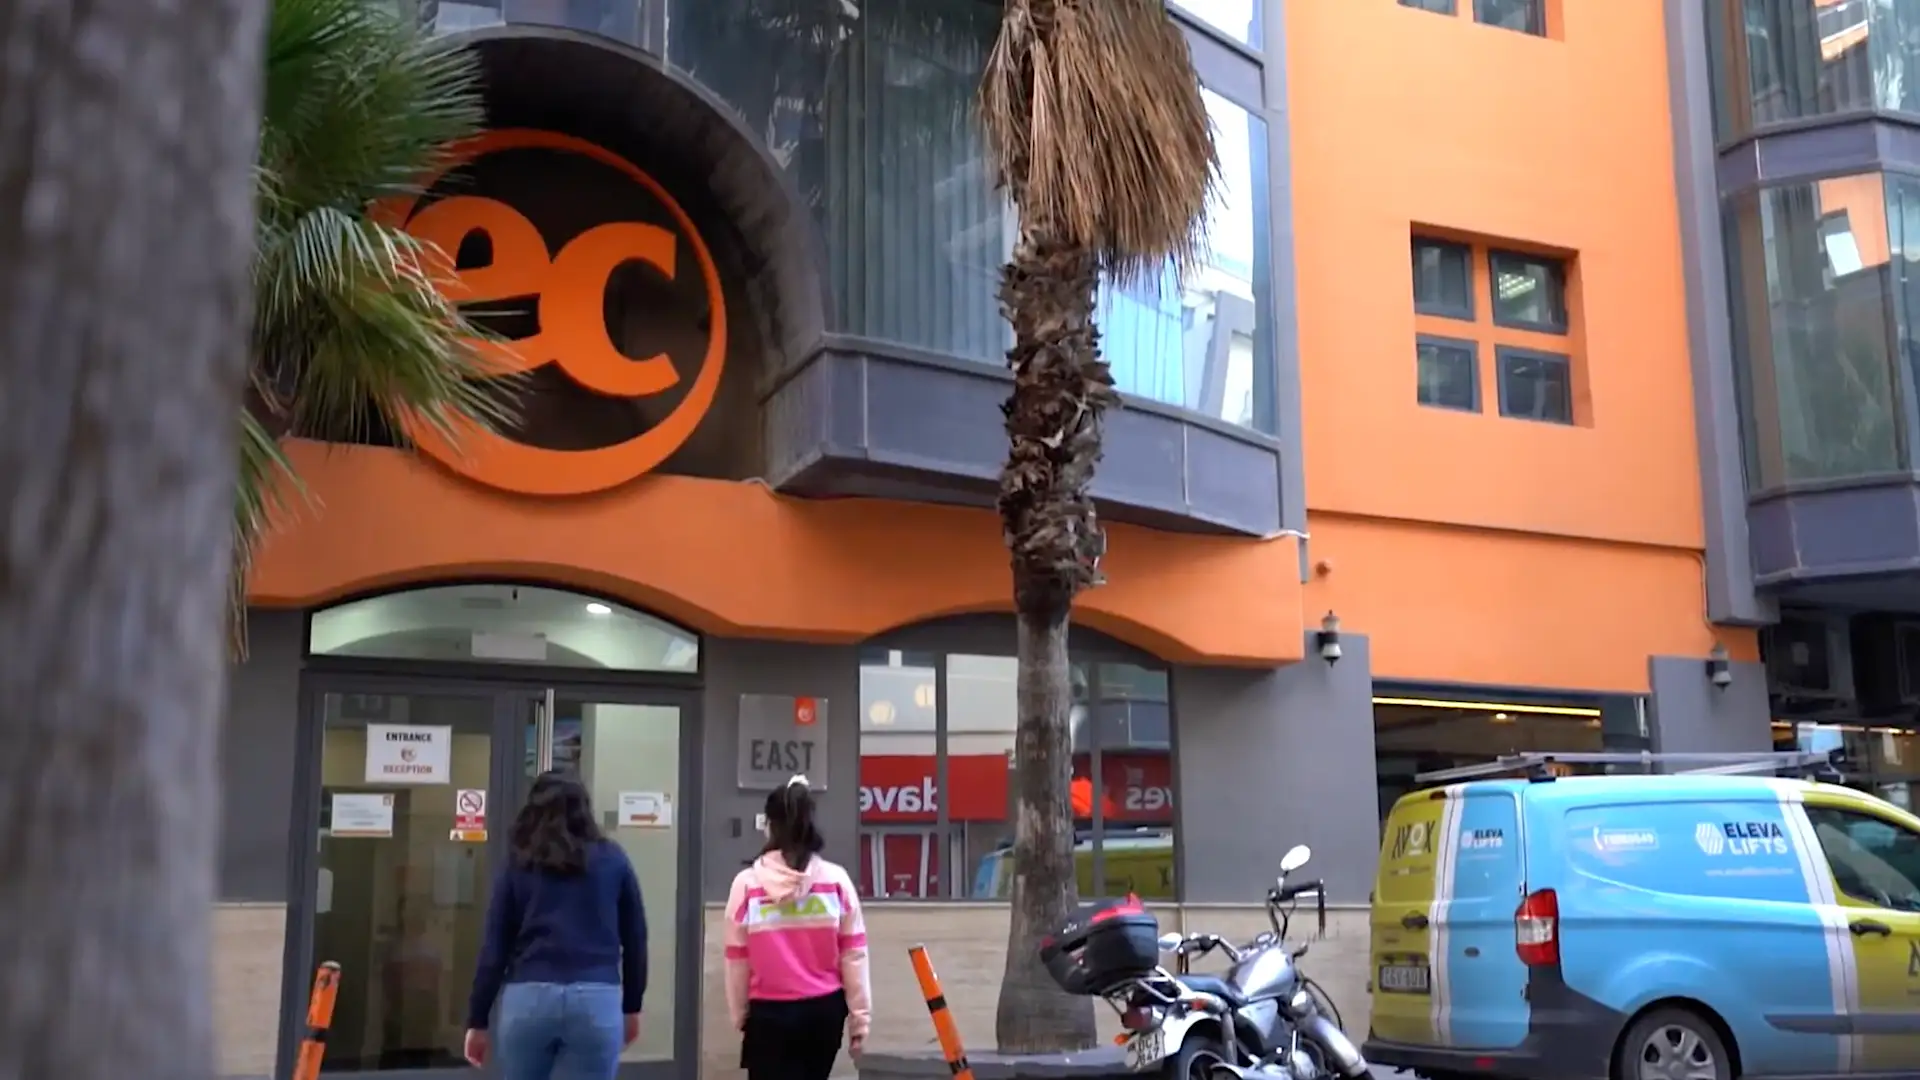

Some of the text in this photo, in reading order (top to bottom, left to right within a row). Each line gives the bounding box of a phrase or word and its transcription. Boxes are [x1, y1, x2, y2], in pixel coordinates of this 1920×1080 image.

[400, 195, 682, 398] ec
[386, 731, 432, 742] ENTRANCE
[751, 739, 815, 771] EAST
[383, 764, 433, 774] RECEPTION
[1474, 828, 1504, 839] ELEVA
[1723, 822, 1783, 838] ELEVA
[1728, 838, 1788, 855] LIFTS
